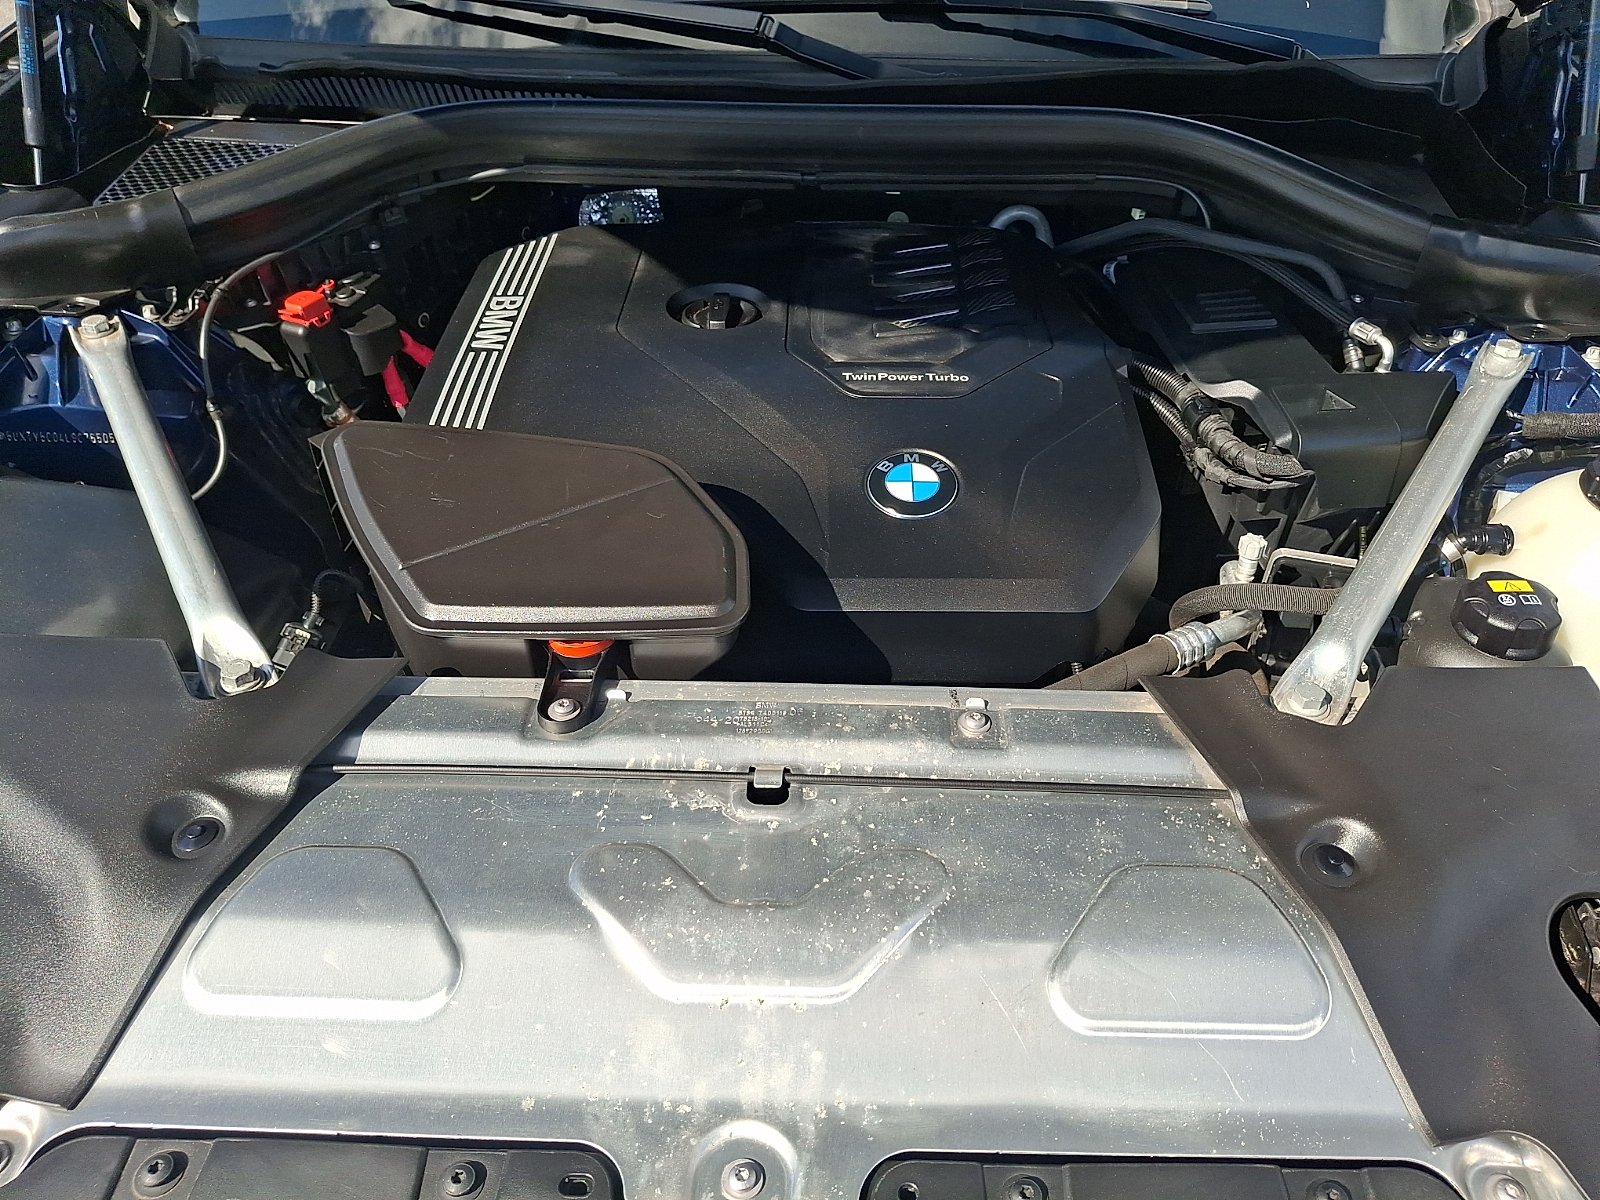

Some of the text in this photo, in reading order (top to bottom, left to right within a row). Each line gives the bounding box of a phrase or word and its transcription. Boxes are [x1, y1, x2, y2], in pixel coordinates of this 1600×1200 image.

[470, 296, 525, 350] BMW
[925, 373, 970, 382] Turbo
[876, 453, 949, 473] BMW
